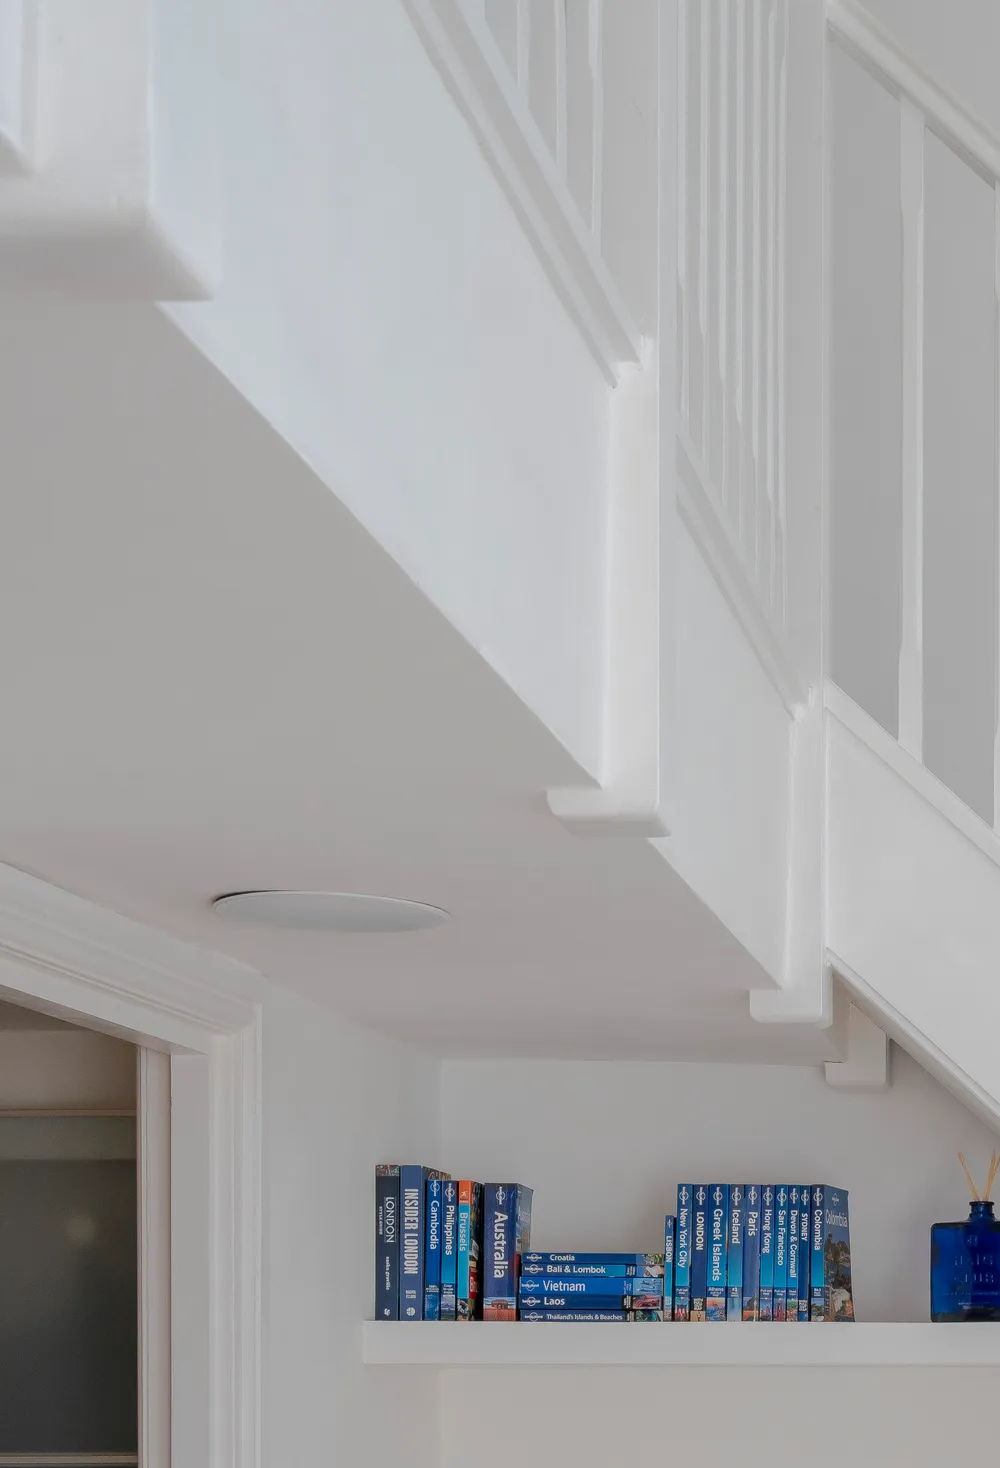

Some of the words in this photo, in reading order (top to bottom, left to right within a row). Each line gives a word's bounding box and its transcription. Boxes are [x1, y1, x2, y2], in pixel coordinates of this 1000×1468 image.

[386, 1197, 394, 1243] LONDON
[405, 1189, 418, 1229] INSIDER
[430, 1200, 439, 1249] Cambodia
[713, 1209, 722, 1240] Greek
[732, 1210, 740, 1243] Iceland
[749, 1212, 757, 1236] Paris
[763, 1209, 771, 1230] Hong
[445, 1205, 454, 1255] Philippines
[460, 1212, 468, 1251] Brussels
[494, 1212, 508, 1278] Australia
[762, 1233, 771, 1253] Kong
[814, 1209, 822, 1250] Colombia
[404, 1234, 418, 1274] LONDON
[678, 1251, 686, 1268] City
[712, 1244, 721, 1280] Islands
[543, 1280, 585, 1291] Vietnam
[544, 1297, 565, 1305] Laos
